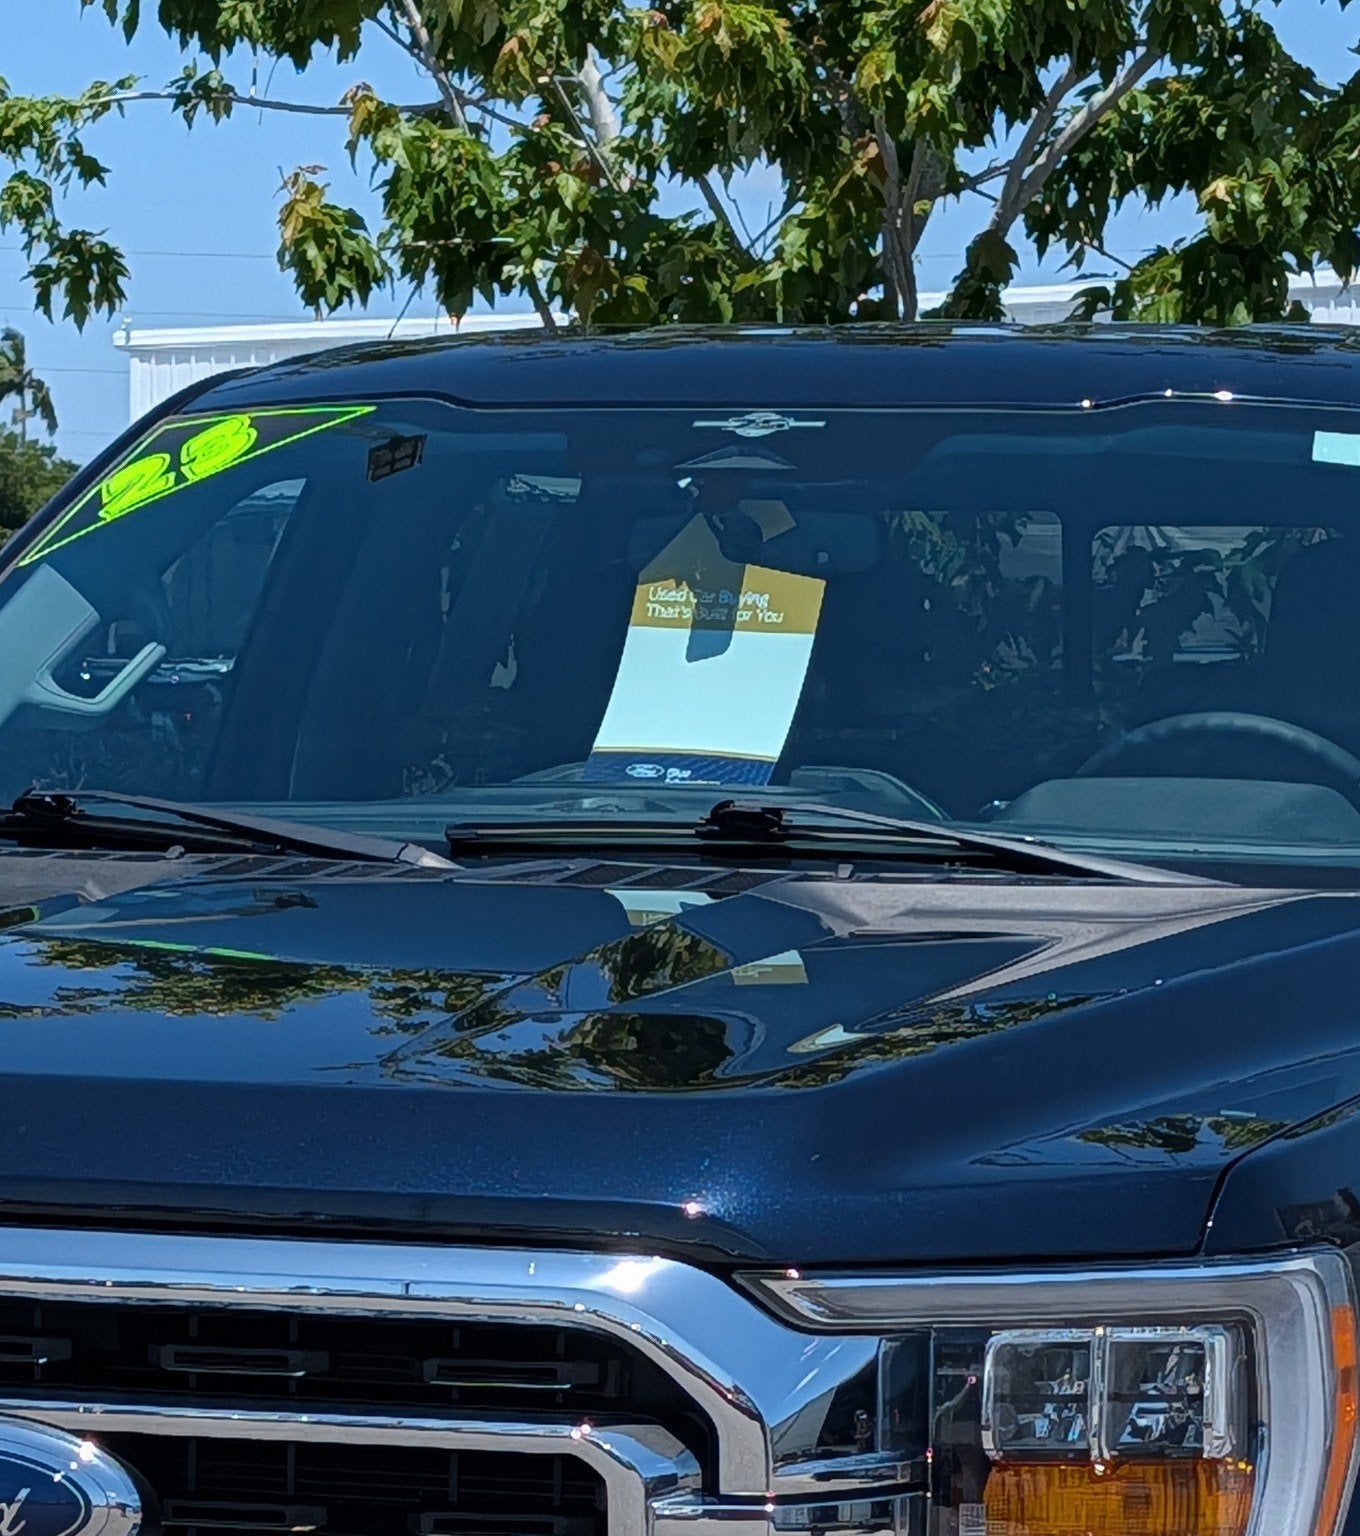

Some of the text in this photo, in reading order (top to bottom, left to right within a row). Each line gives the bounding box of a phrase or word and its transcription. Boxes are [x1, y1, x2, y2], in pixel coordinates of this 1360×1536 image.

[98, 414, 258, 522] 23
[648, 584, 687, 602] Used
[646, 602, 690, 619] That's
[755, 607, 785, 623] You
